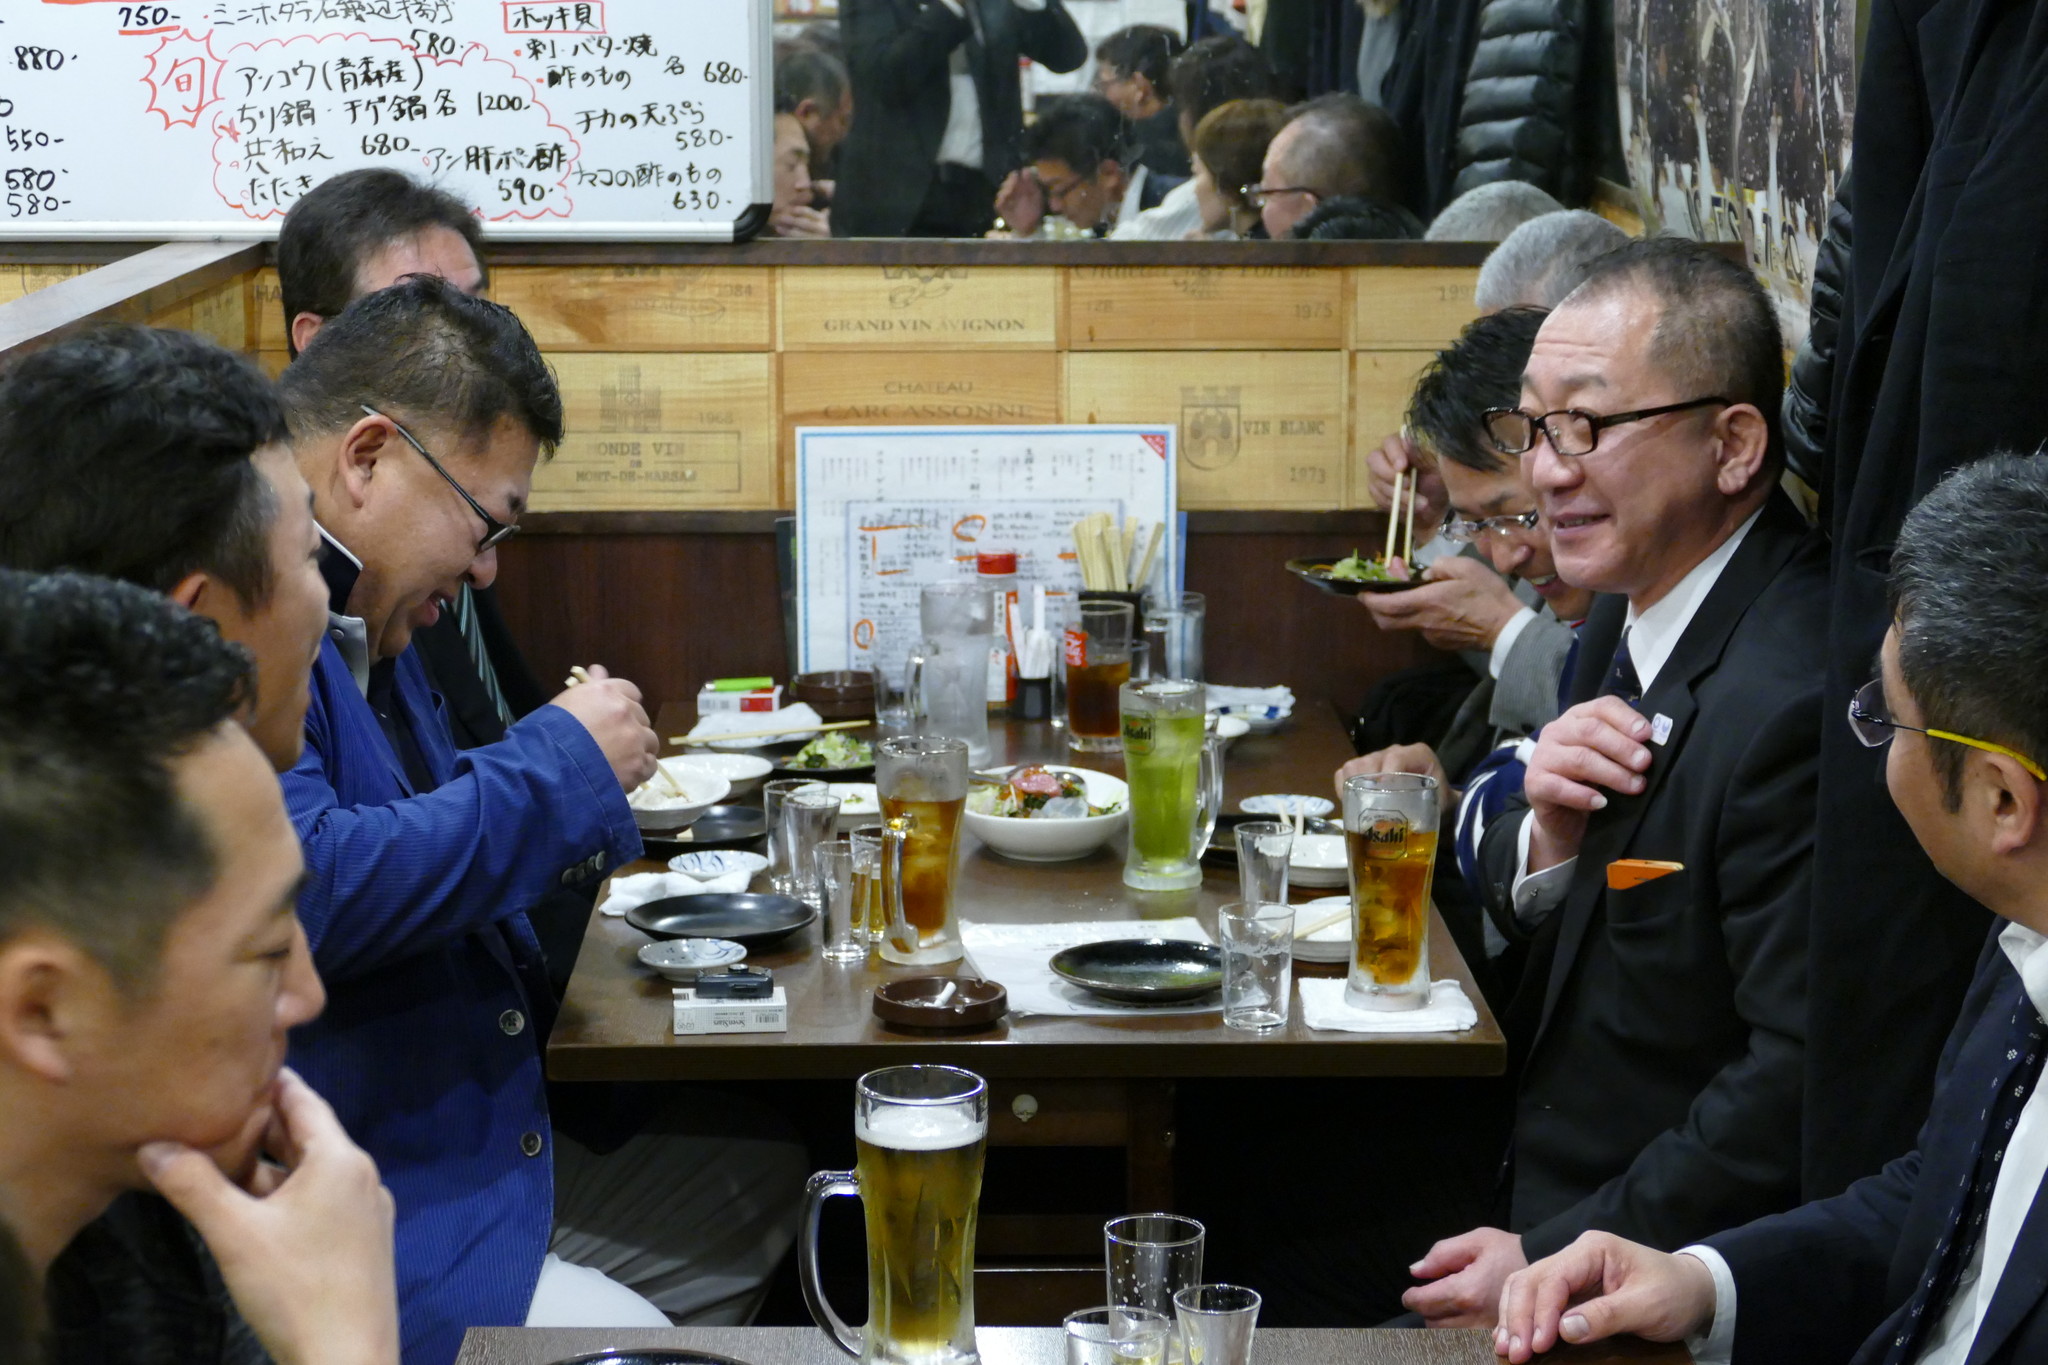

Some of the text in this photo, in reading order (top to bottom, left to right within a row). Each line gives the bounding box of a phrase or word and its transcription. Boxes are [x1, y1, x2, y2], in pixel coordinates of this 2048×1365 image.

[512, 3, 599, 31] ホッキ貝
[161, 57, 206, 112] 旬
[575, 101, 705, 134] チカの天ぷら
[823, 317, 894, 332] GRAND
[899, 317, 932, 332] VIN
[883, 380, 974, 395] CHATEAU
[1363, 825, 1405, 844] Asahi
